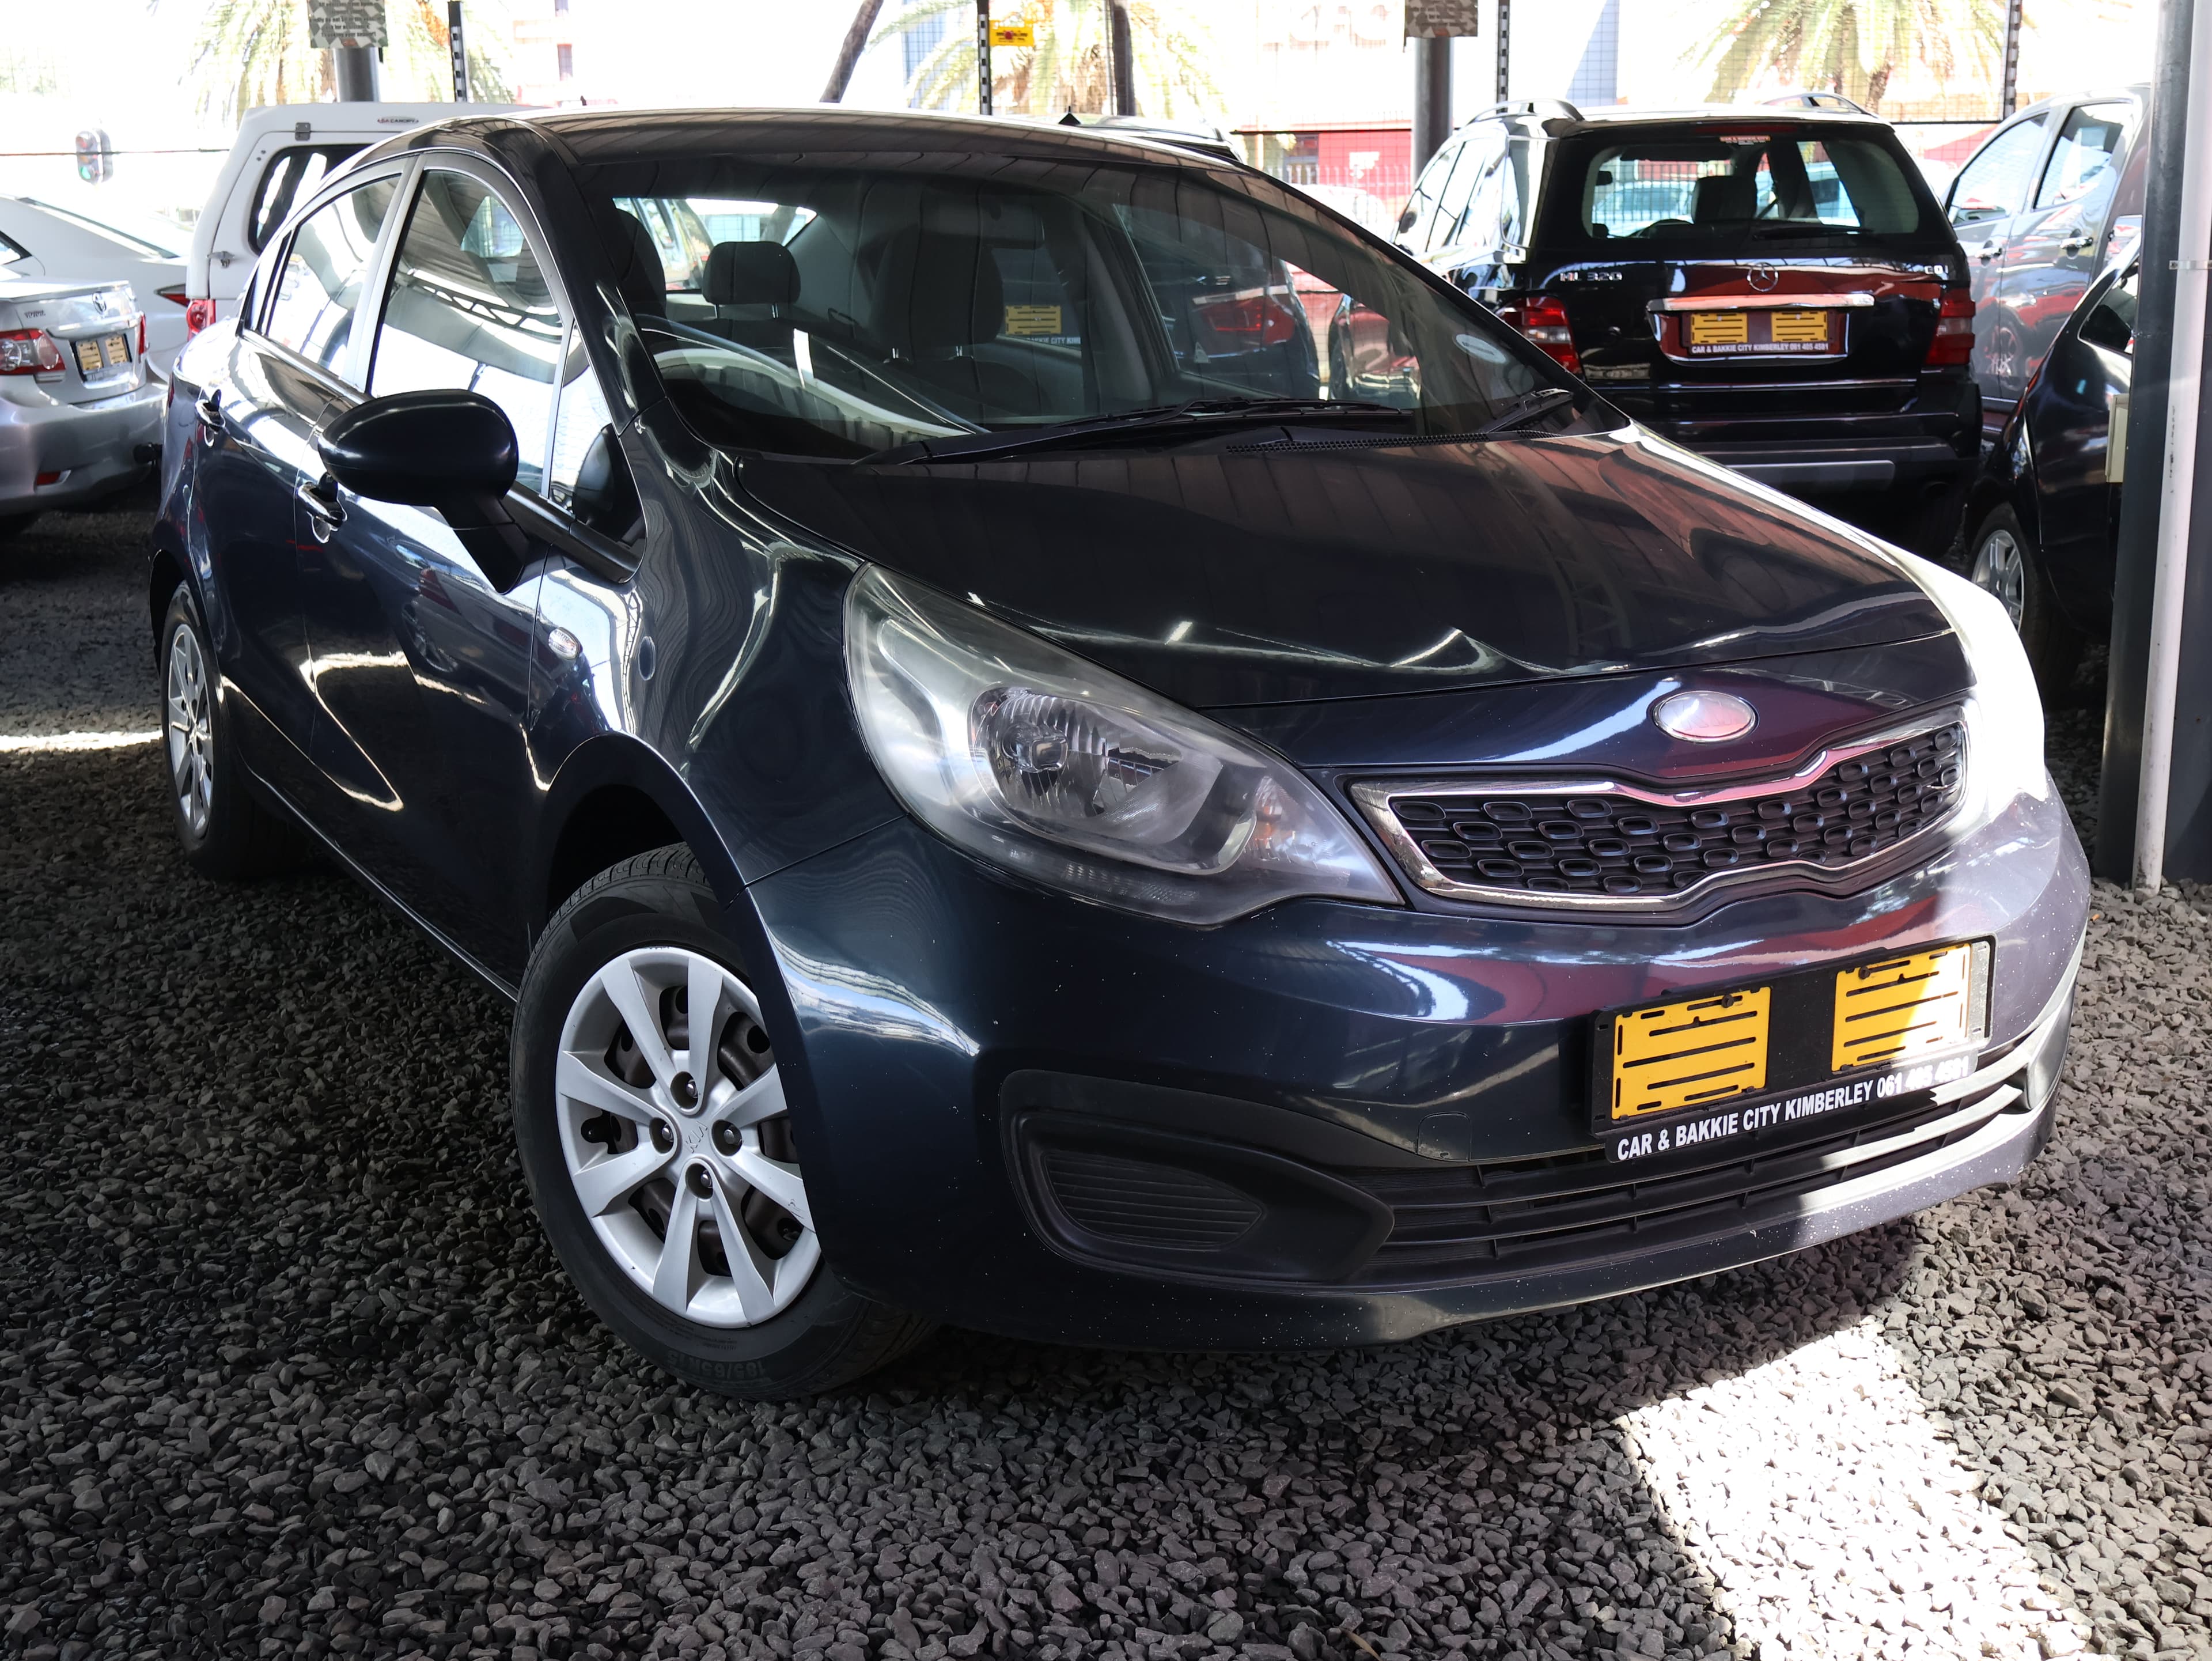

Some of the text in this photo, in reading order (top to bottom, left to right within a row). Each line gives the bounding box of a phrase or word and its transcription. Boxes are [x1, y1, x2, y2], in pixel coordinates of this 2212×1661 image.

[1587, 271, 1623, 281] 320
[1051, 336, 1065, 345] CITY
[1691, 345, 1706, 354] CAR
[1706, 345, 1711, 353] &
[1713, 344, 1737, 353] BAKKIE
[1737, 343, 1753, 352] CITY
[1753, 343, 1789, 351] KIMBERLEY
[1618, 1133, 1653, 1160] CAR
[1658, 1129, 1670, 1151] &
[1675, 1113, 1738, 1147] BAKKIE
[1743, 1103, 1781, 1130] CITY
[1785, 1080, 1873, 1121] KIMBERLEY
[1877, 1072, 1903, 1098] 061
[685, 1121, 709, 1153] KIA
